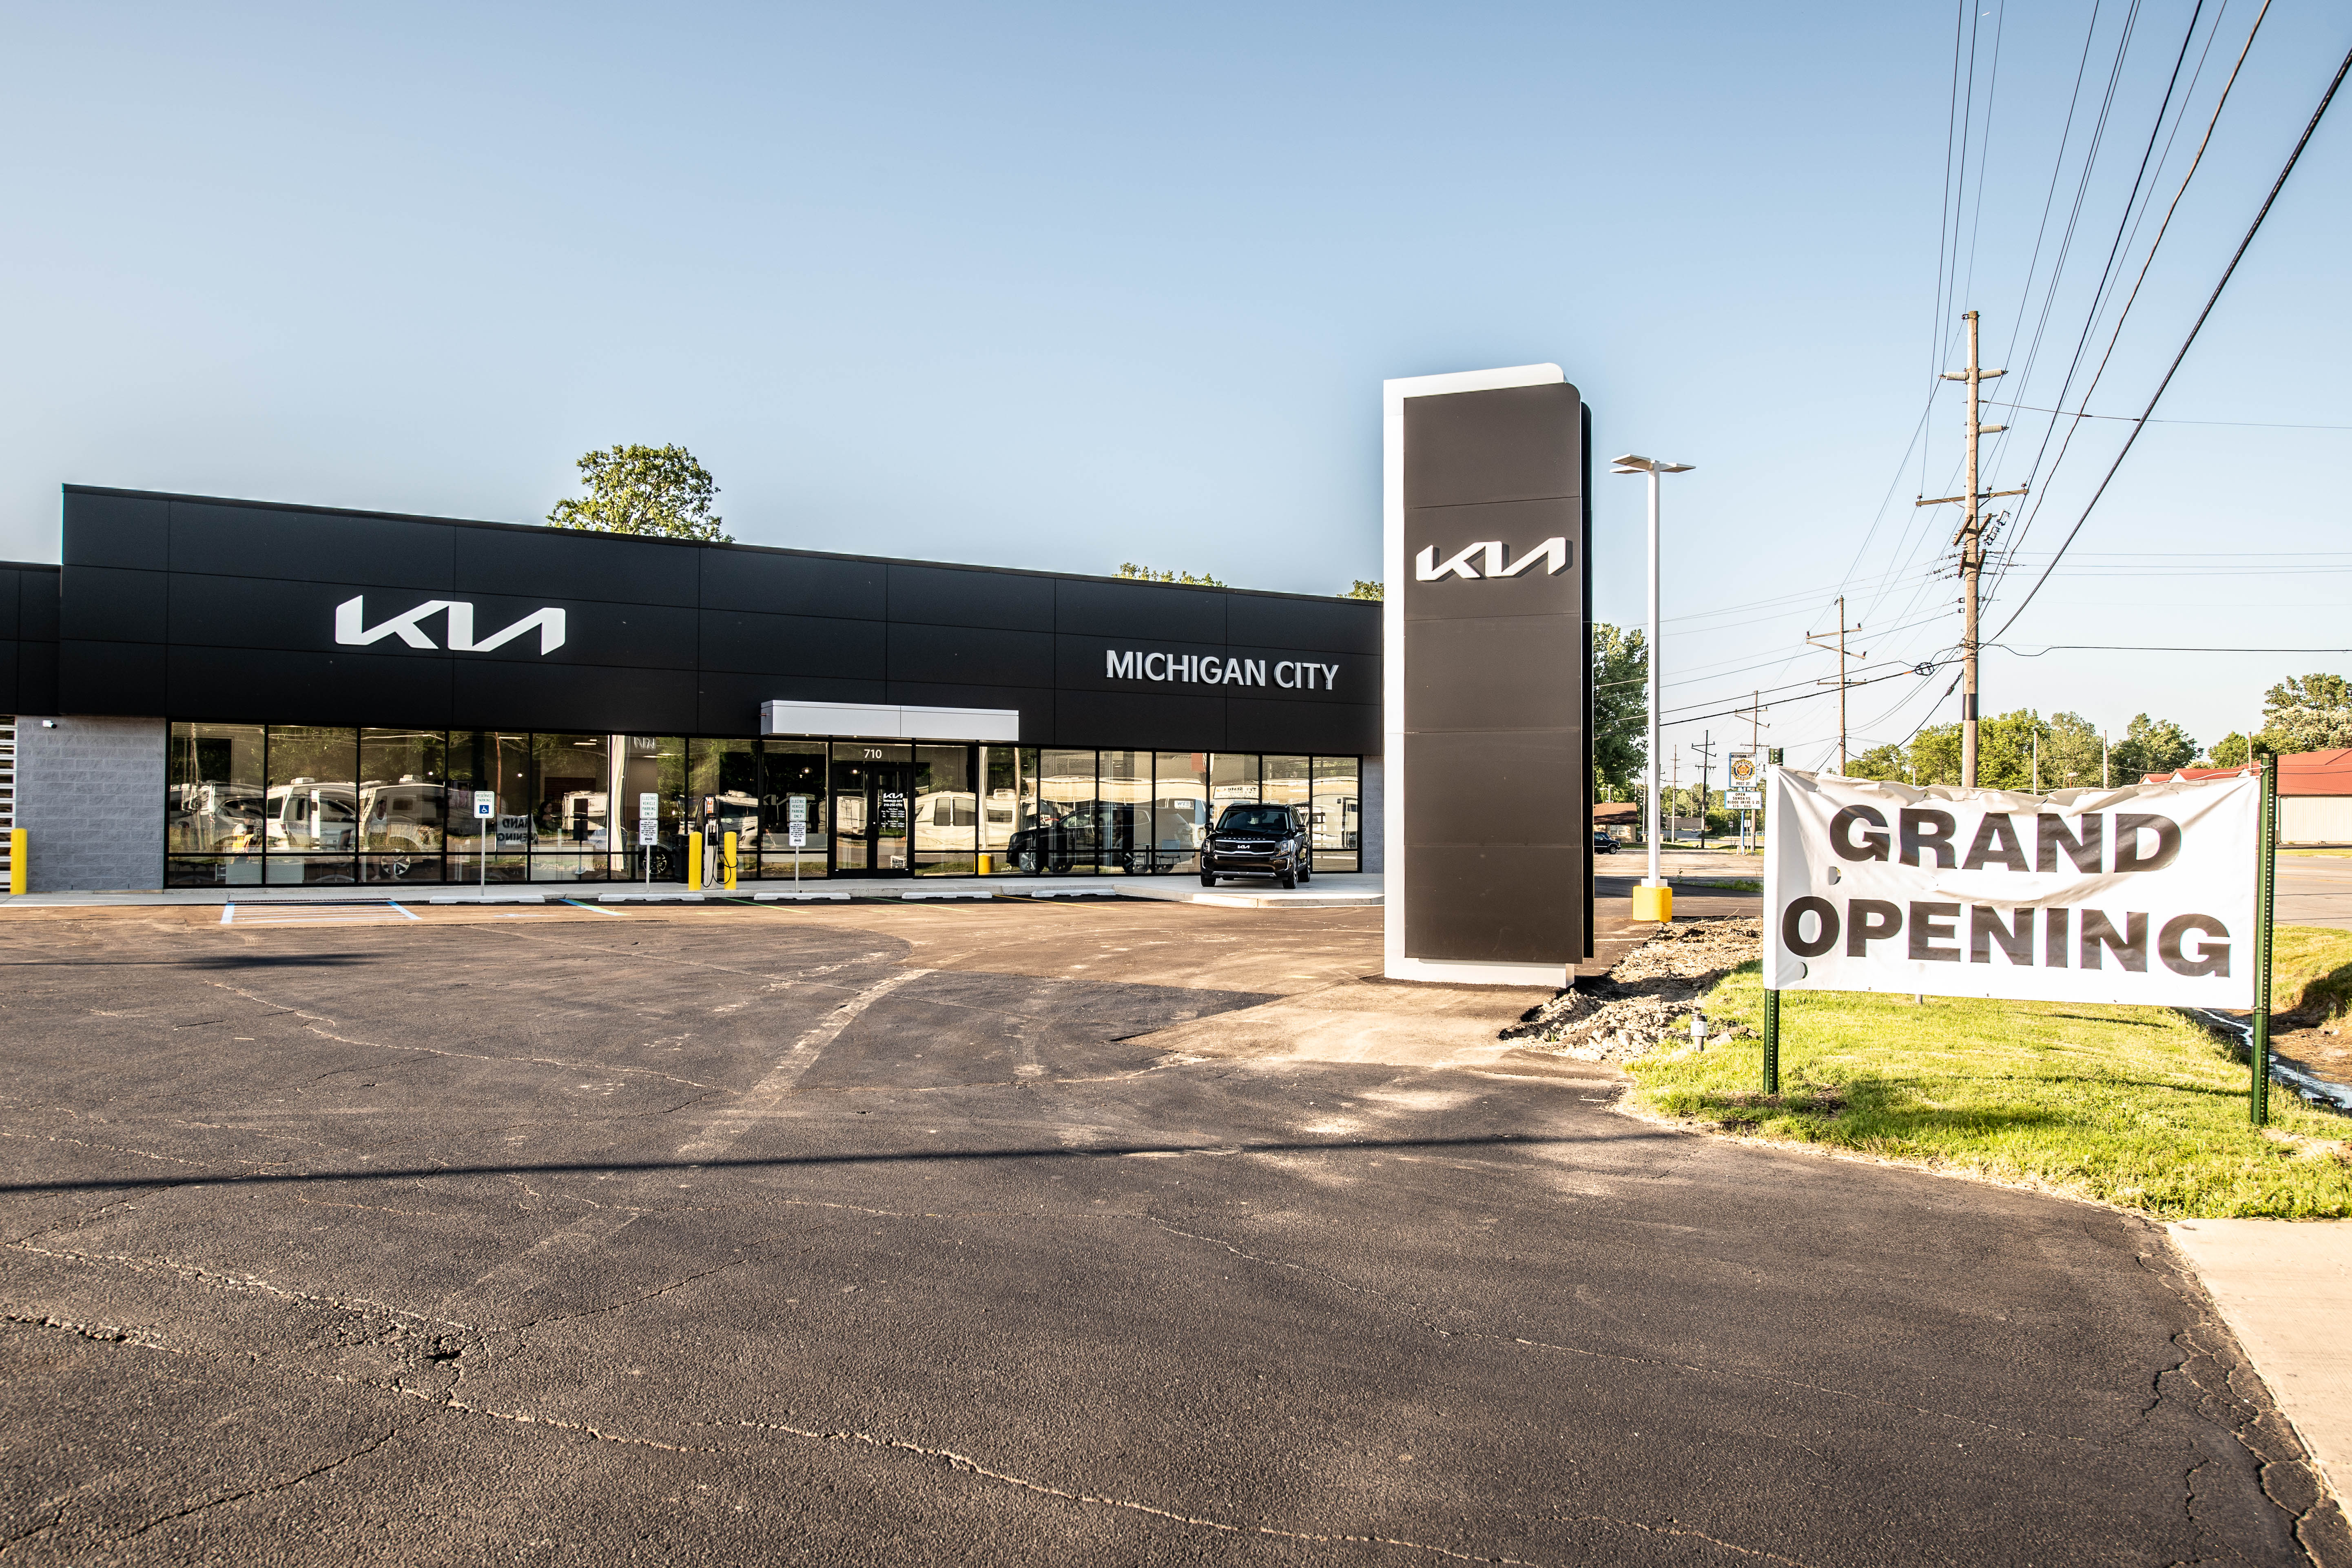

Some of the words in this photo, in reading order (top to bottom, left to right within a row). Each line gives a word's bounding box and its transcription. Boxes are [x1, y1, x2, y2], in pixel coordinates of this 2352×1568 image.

[1415, 537, 1566, 581] KIA
[335, 595, 566, 656] KIA
[1106, 650, 1266, 687] MICHIGAN
[1274, 661, 1339, 690] CITY
[864, 749, 882, 759] 710
[1830, 804, 2181, 874] GRAND
[1782, 896, 2231, 978] OPENING
